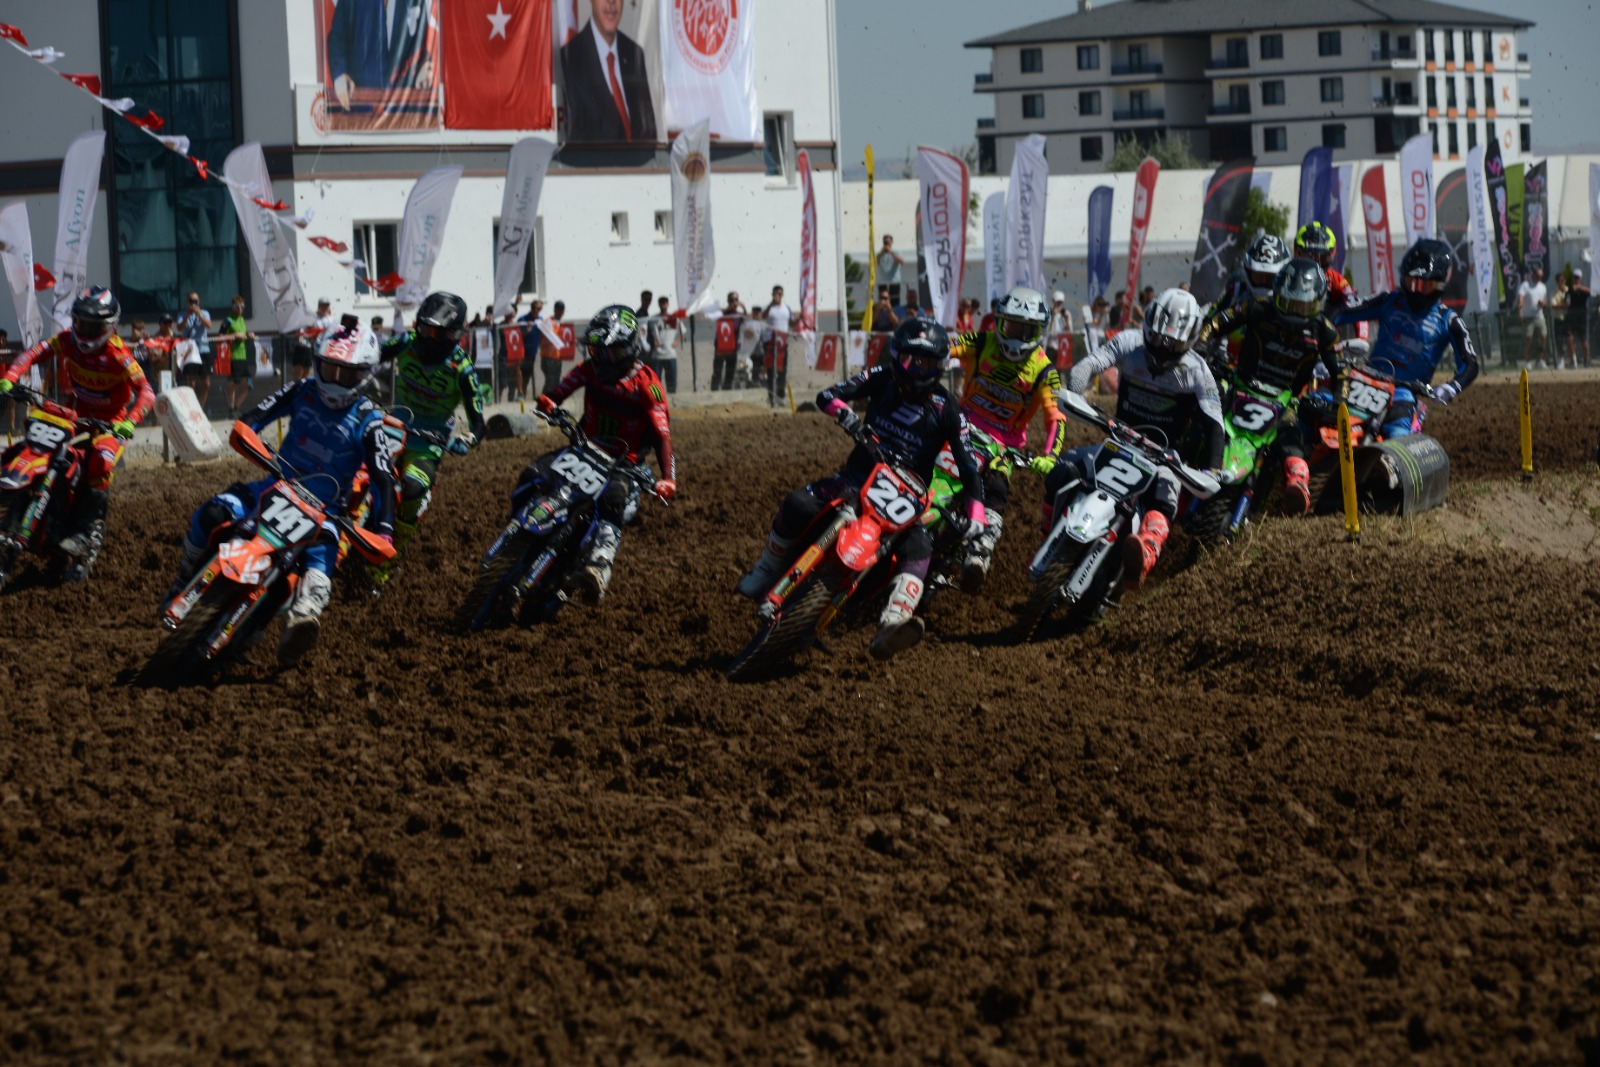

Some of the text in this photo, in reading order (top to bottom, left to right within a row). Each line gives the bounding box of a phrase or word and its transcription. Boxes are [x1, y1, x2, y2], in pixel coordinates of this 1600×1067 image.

[65, 188, 87, 255] Afyon
[501, 225, 523, 257] NG
[1128, 401, 1174, 423] Husqvarna
[1347, 380, 1391, 414] 265
[875, 415, 923, 447] HONDA
[1232, 402, 1274, 431] 3
[27, 421, 66, 449] 92
[551, 453, 607, 500] 295
[1096, 457, 1143, 496] 2
[867, 478, 915, 525] 20
[261, 495, 317, 544] 141
